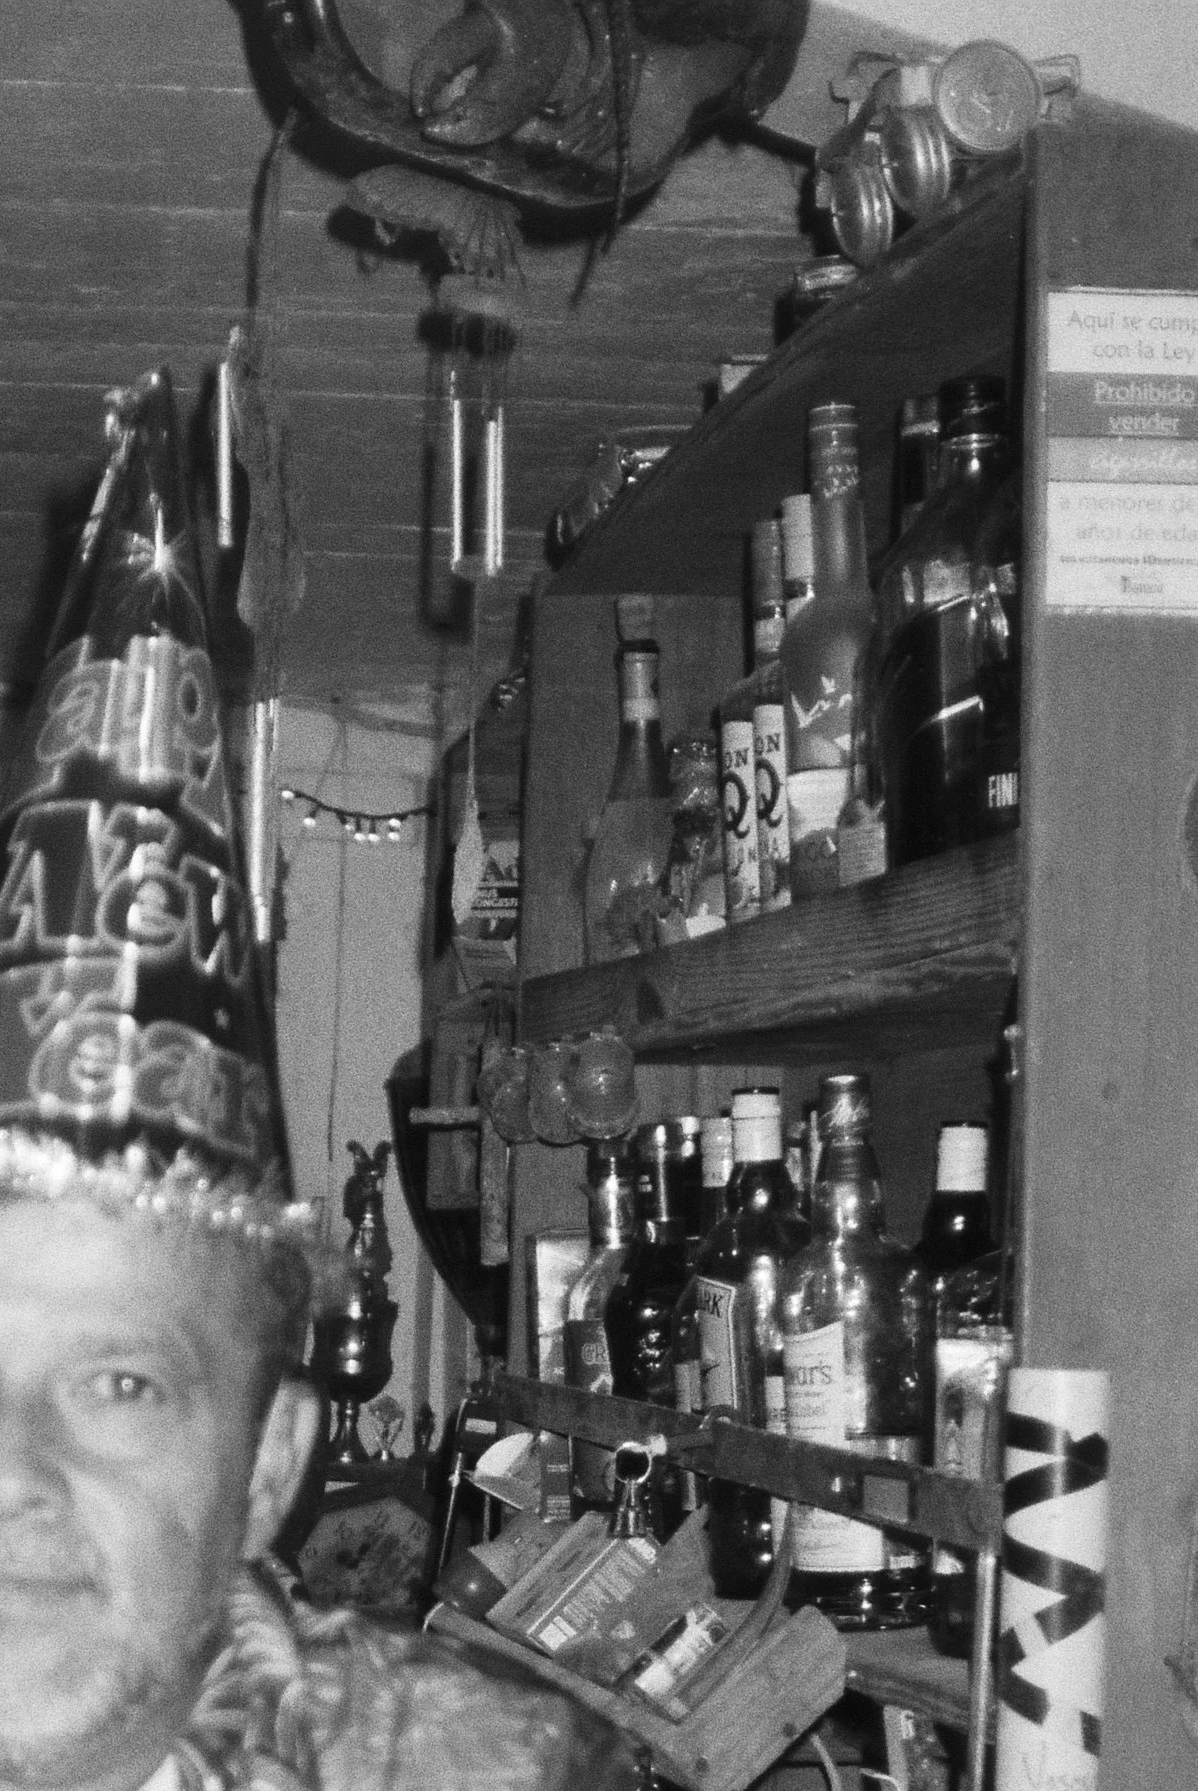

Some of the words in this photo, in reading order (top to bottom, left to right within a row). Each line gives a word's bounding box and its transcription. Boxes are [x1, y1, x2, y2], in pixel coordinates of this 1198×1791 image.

[1066, 310, 1117, 334] Aquí
[1122, 315, 1143, 330] se
[1147, 315, 1198, 335] cump
[1092, 344, 1131, 359] con
[1137, 339, 1154, 359] la
[1162, 341, 1197, 364] Ley
[1093, 380, 1196, 403] Prohibido
[1107, 411, 1181, 432] vender
